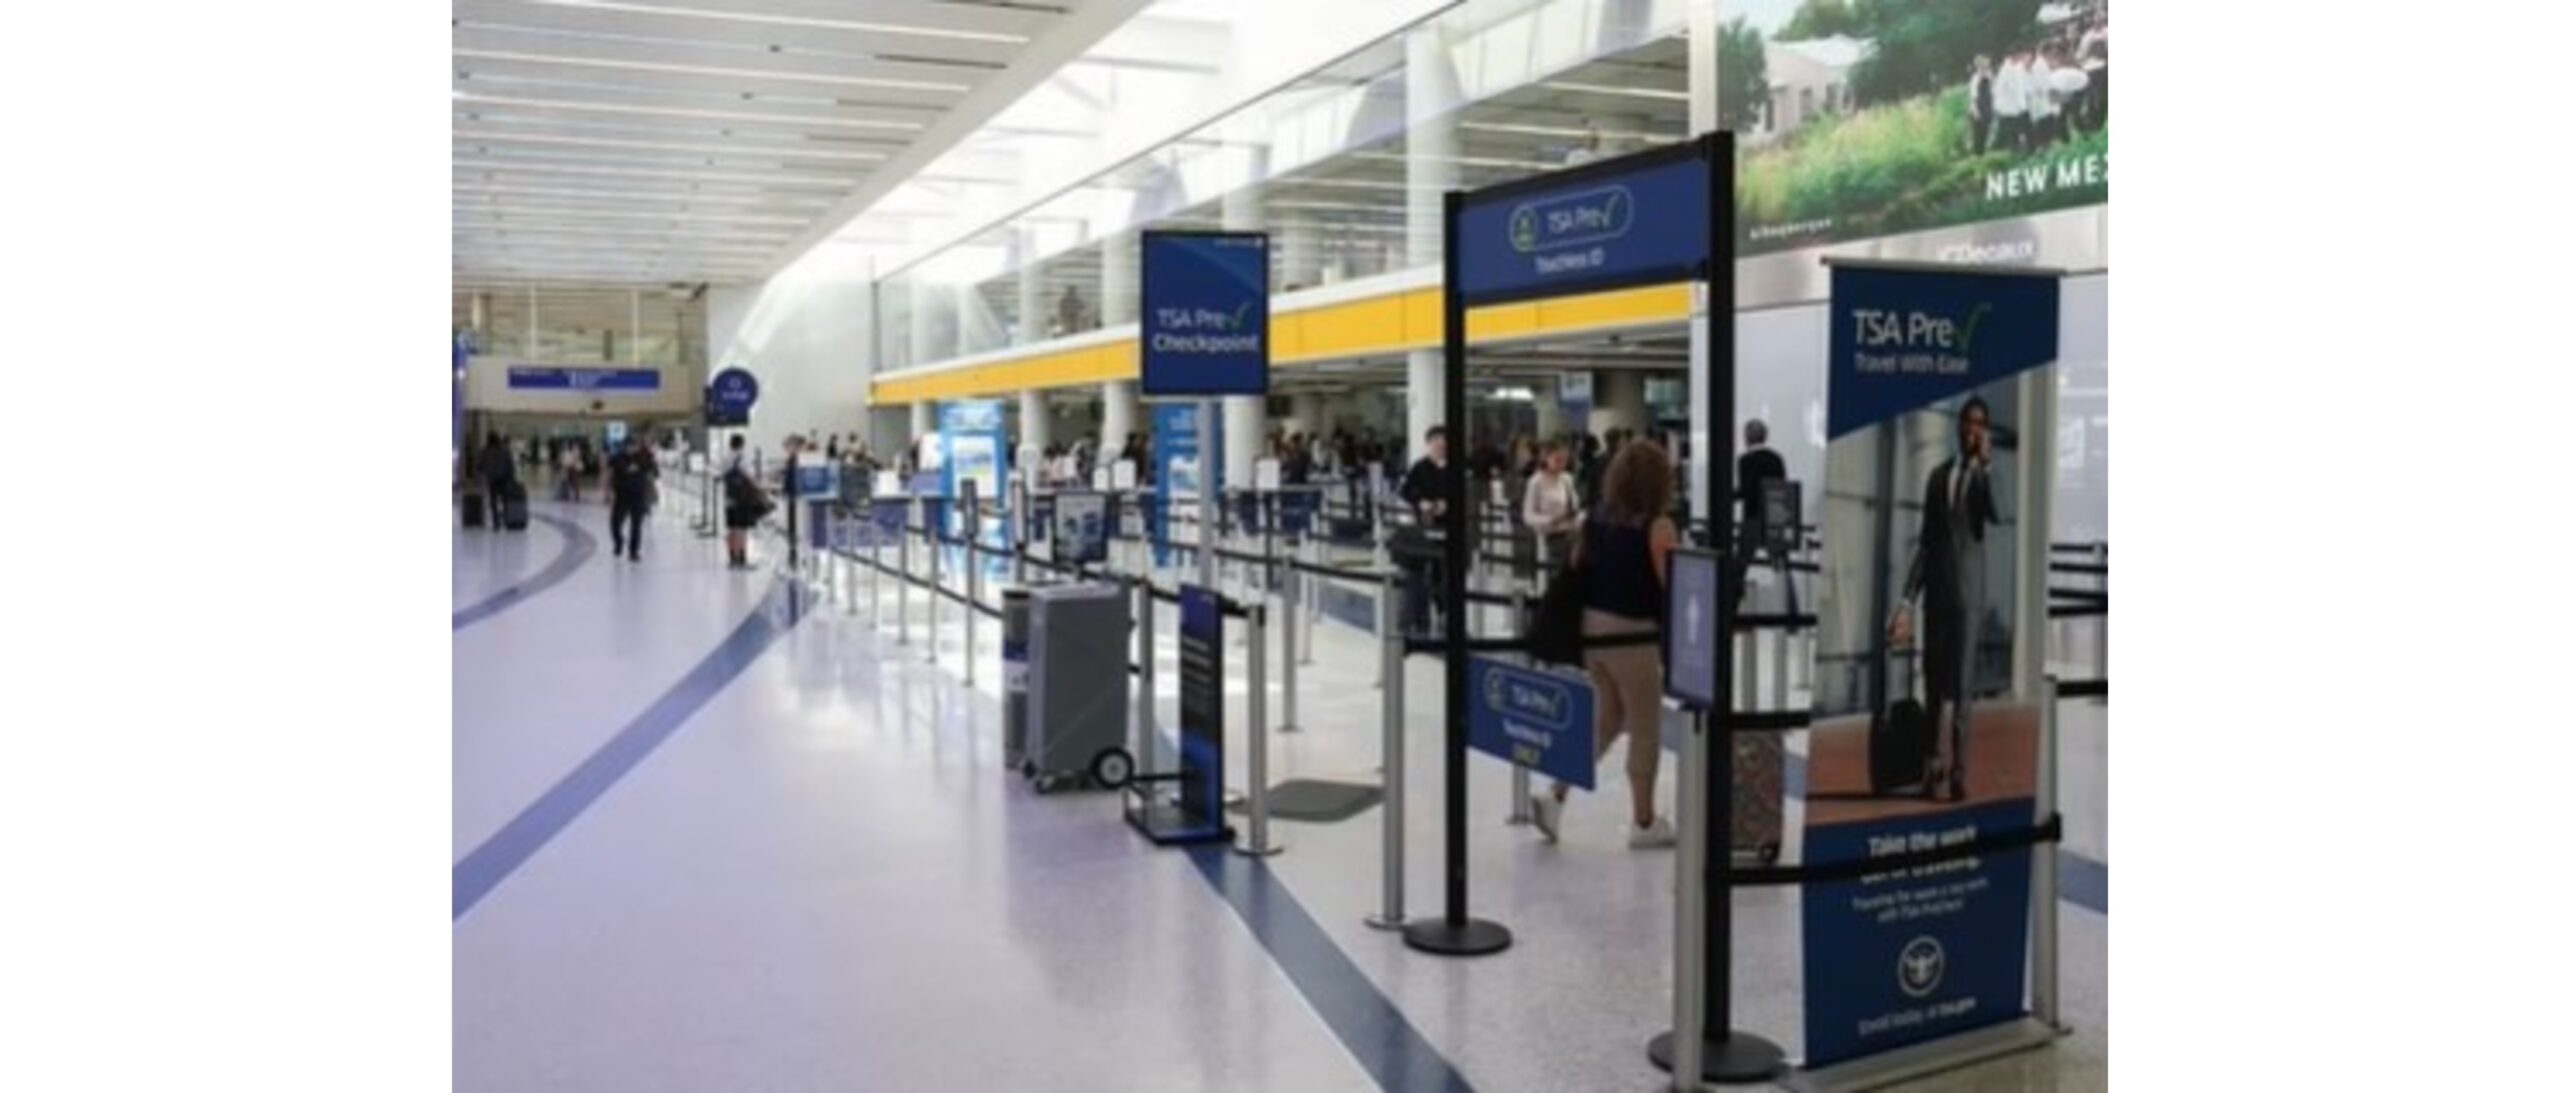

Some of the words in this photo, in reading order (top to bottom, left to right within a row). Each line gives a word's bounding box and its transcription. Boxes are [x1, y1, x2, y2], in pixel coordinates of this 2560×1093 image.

[1986, 163, 2047, 200] NEW
[1547, 210, 1573, 233] TSA
[1157, 308, 1191, 330] TSA
[1194, 308, 1226, 330] Pre
[1852, 308, 1902, 346] TSA
[1908, 310, 1954, 348] Pre
[1152, 333, 1259, 353] Checkpoint
[1854, 352, 1897, 374] Travel
[1868, 833, 1907, 857] Take
[1908, 831, 1938, 853] the
